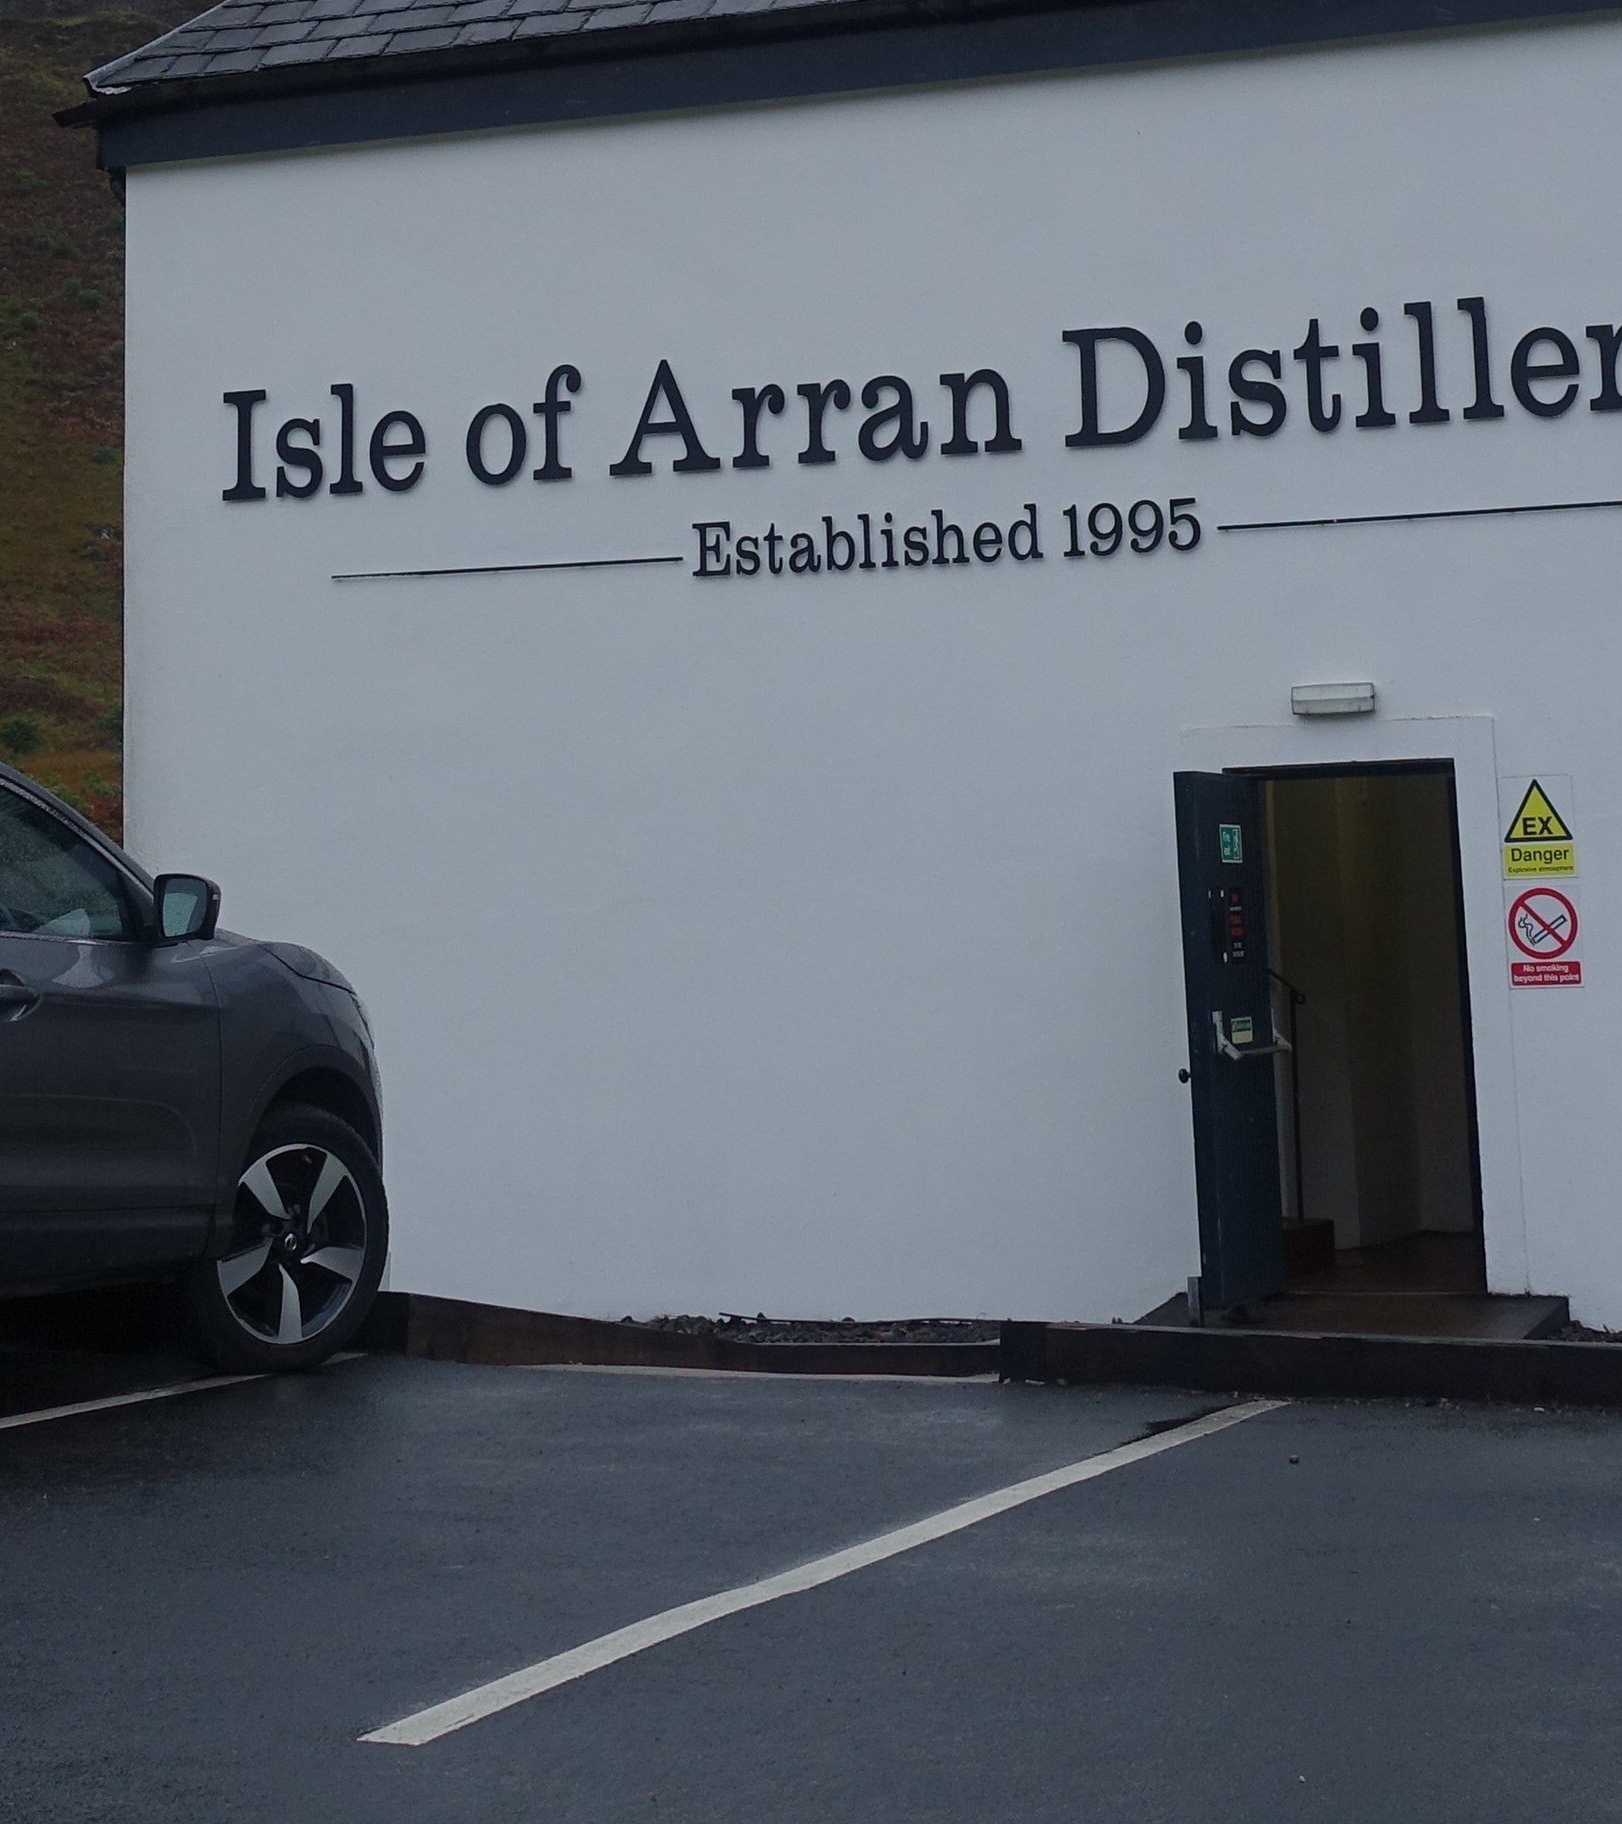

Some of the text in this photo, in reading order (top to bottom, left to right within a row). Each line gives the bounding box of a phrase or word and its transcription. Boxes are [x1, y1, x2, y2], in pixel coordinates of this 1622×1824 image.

[222, 383, 427, 504] Isle
[465, 364, 582, 489] of
[609, 359, 1023, 479] Arran
[691, 497, 1202, 579] Established 1995
[1522, 816, 1553, 836] EX
[1511, 848, 1569, 864] Danger
[1522, 964, 1569, 973] No smoking
[1514, 973, 1579, 984] beyond this point
